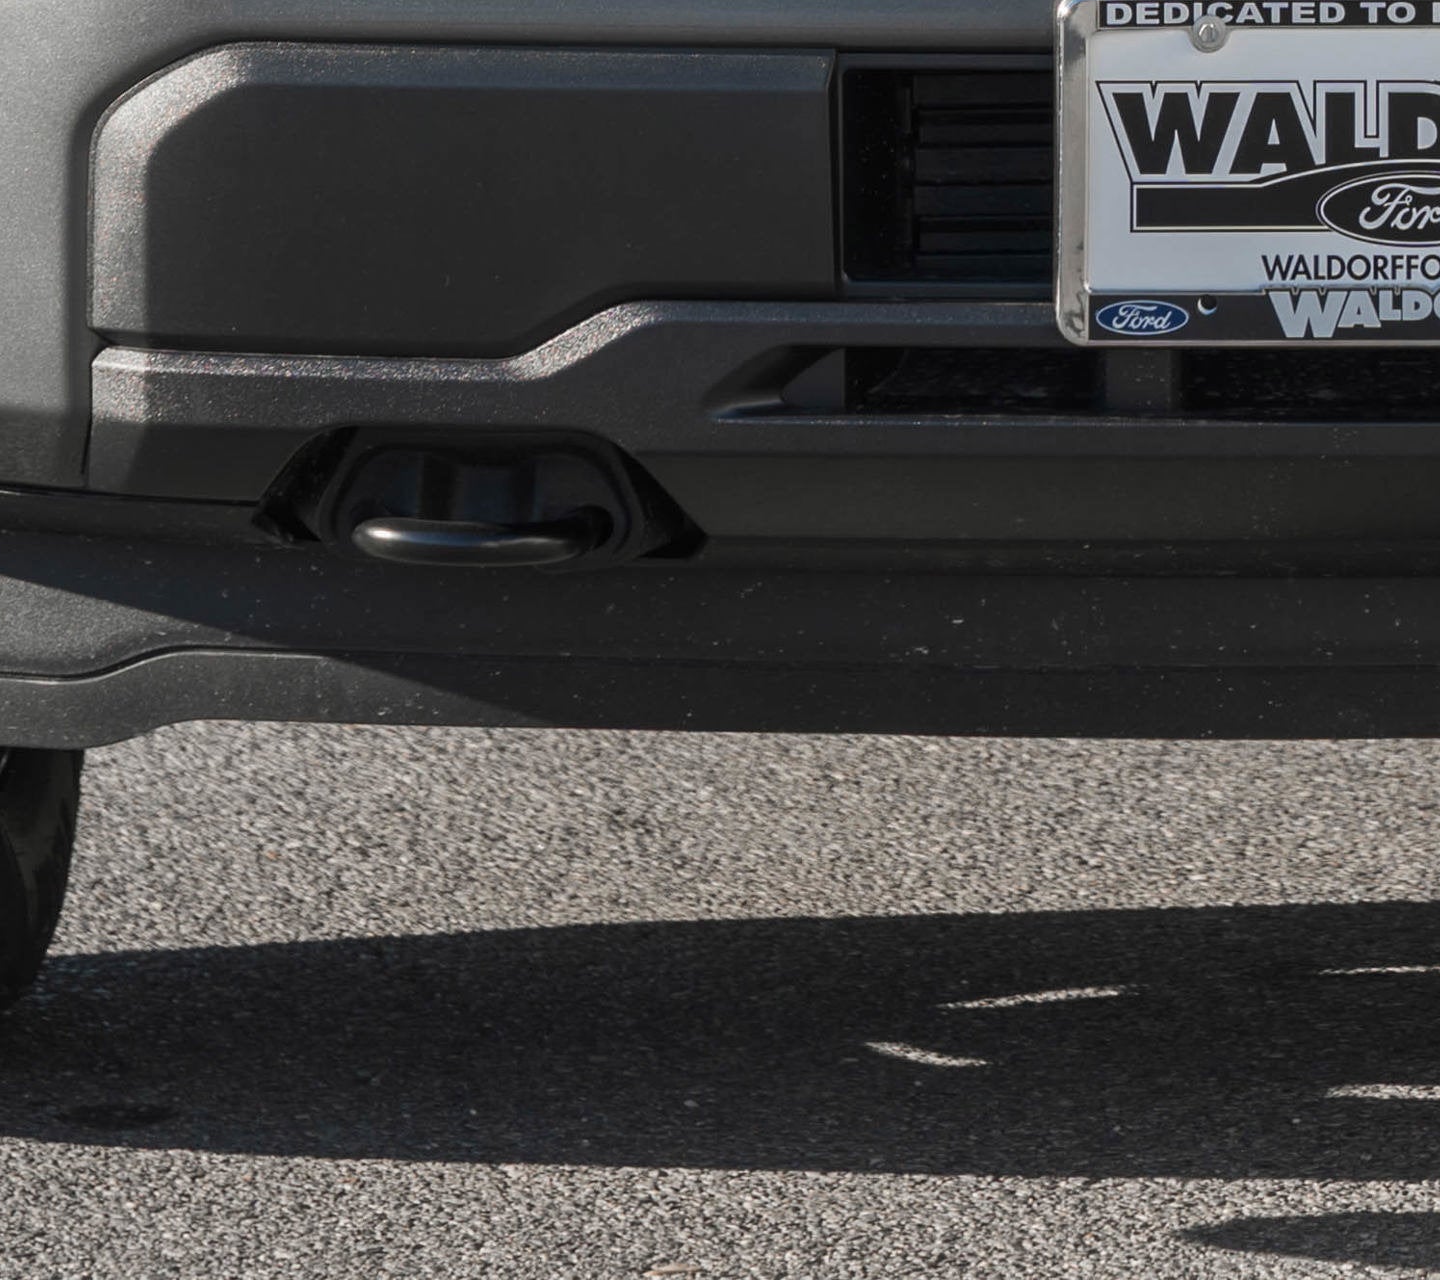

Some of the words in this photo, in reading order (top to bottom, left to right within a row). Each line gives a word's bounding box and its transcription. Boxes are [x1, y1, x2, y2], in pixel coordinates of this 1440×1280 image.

[1106, 1, 1346, 25] DEDICATED
[1360, 1, 1417, 24] TO
[1112, 304, 1173, 329] Ford
